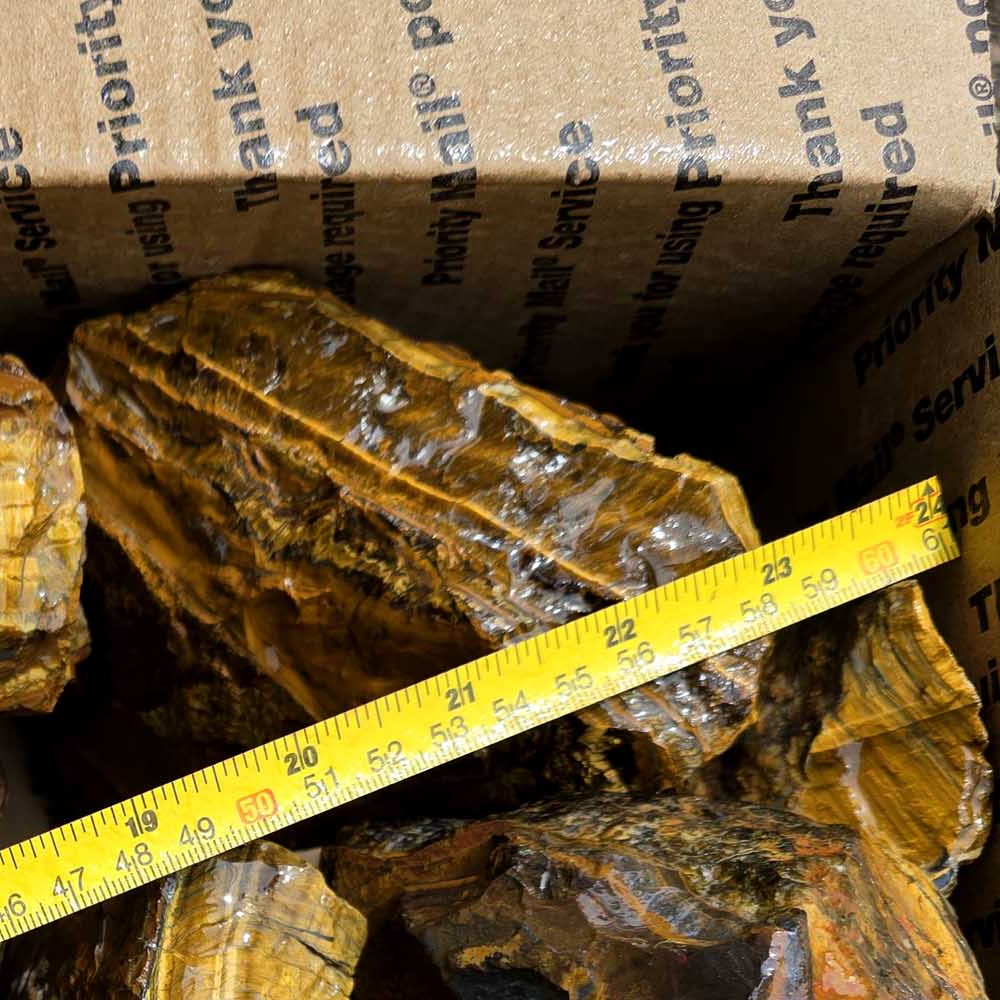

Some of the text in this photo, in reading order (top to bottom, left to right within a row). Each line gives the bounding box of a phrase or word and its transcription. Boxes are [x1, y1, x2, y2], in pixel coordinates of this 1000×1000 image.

[213, 60, 280, 213] Thank
[294, 102, 367, 248] required
[407, 72, 479, 204] Mail®
[539, 120, 600, 250] Service
[777, 59, 843, 222] Thank
[841, 100, 918, 268] required
[124, 198, 175, 258] using
[420, 208, 482, 287] Priority
[632, 270, 682, 302] for
[655, 200, 724, 267] using
[853, 247, 969, 389] Priority
[52, 867, 86, 898] 47
[115, 842, 154, 873] 48
[178, 816, 217, 847] 49
[239, 793, 275, 821] 50
[303, 766, 340, 799] 51
[367, 740, 405, 773] 52
[430, 715, 469, 748] 53
[492, 689, 531, 722] 54
[555, 665, 594, 698] 55
[616, 641, 655, 669] 56
[678, 616, 713, 642] 57
[740, 592, 779, 623] 58
[801, 568, 839, 600] 59
[125, 809, 158, 838] 19
[284, 745, 318, 775] 20
[444, 681, 475, 712] 21
[603, 618, 637, 648] 22
[760, 556, 793, 586] 23
